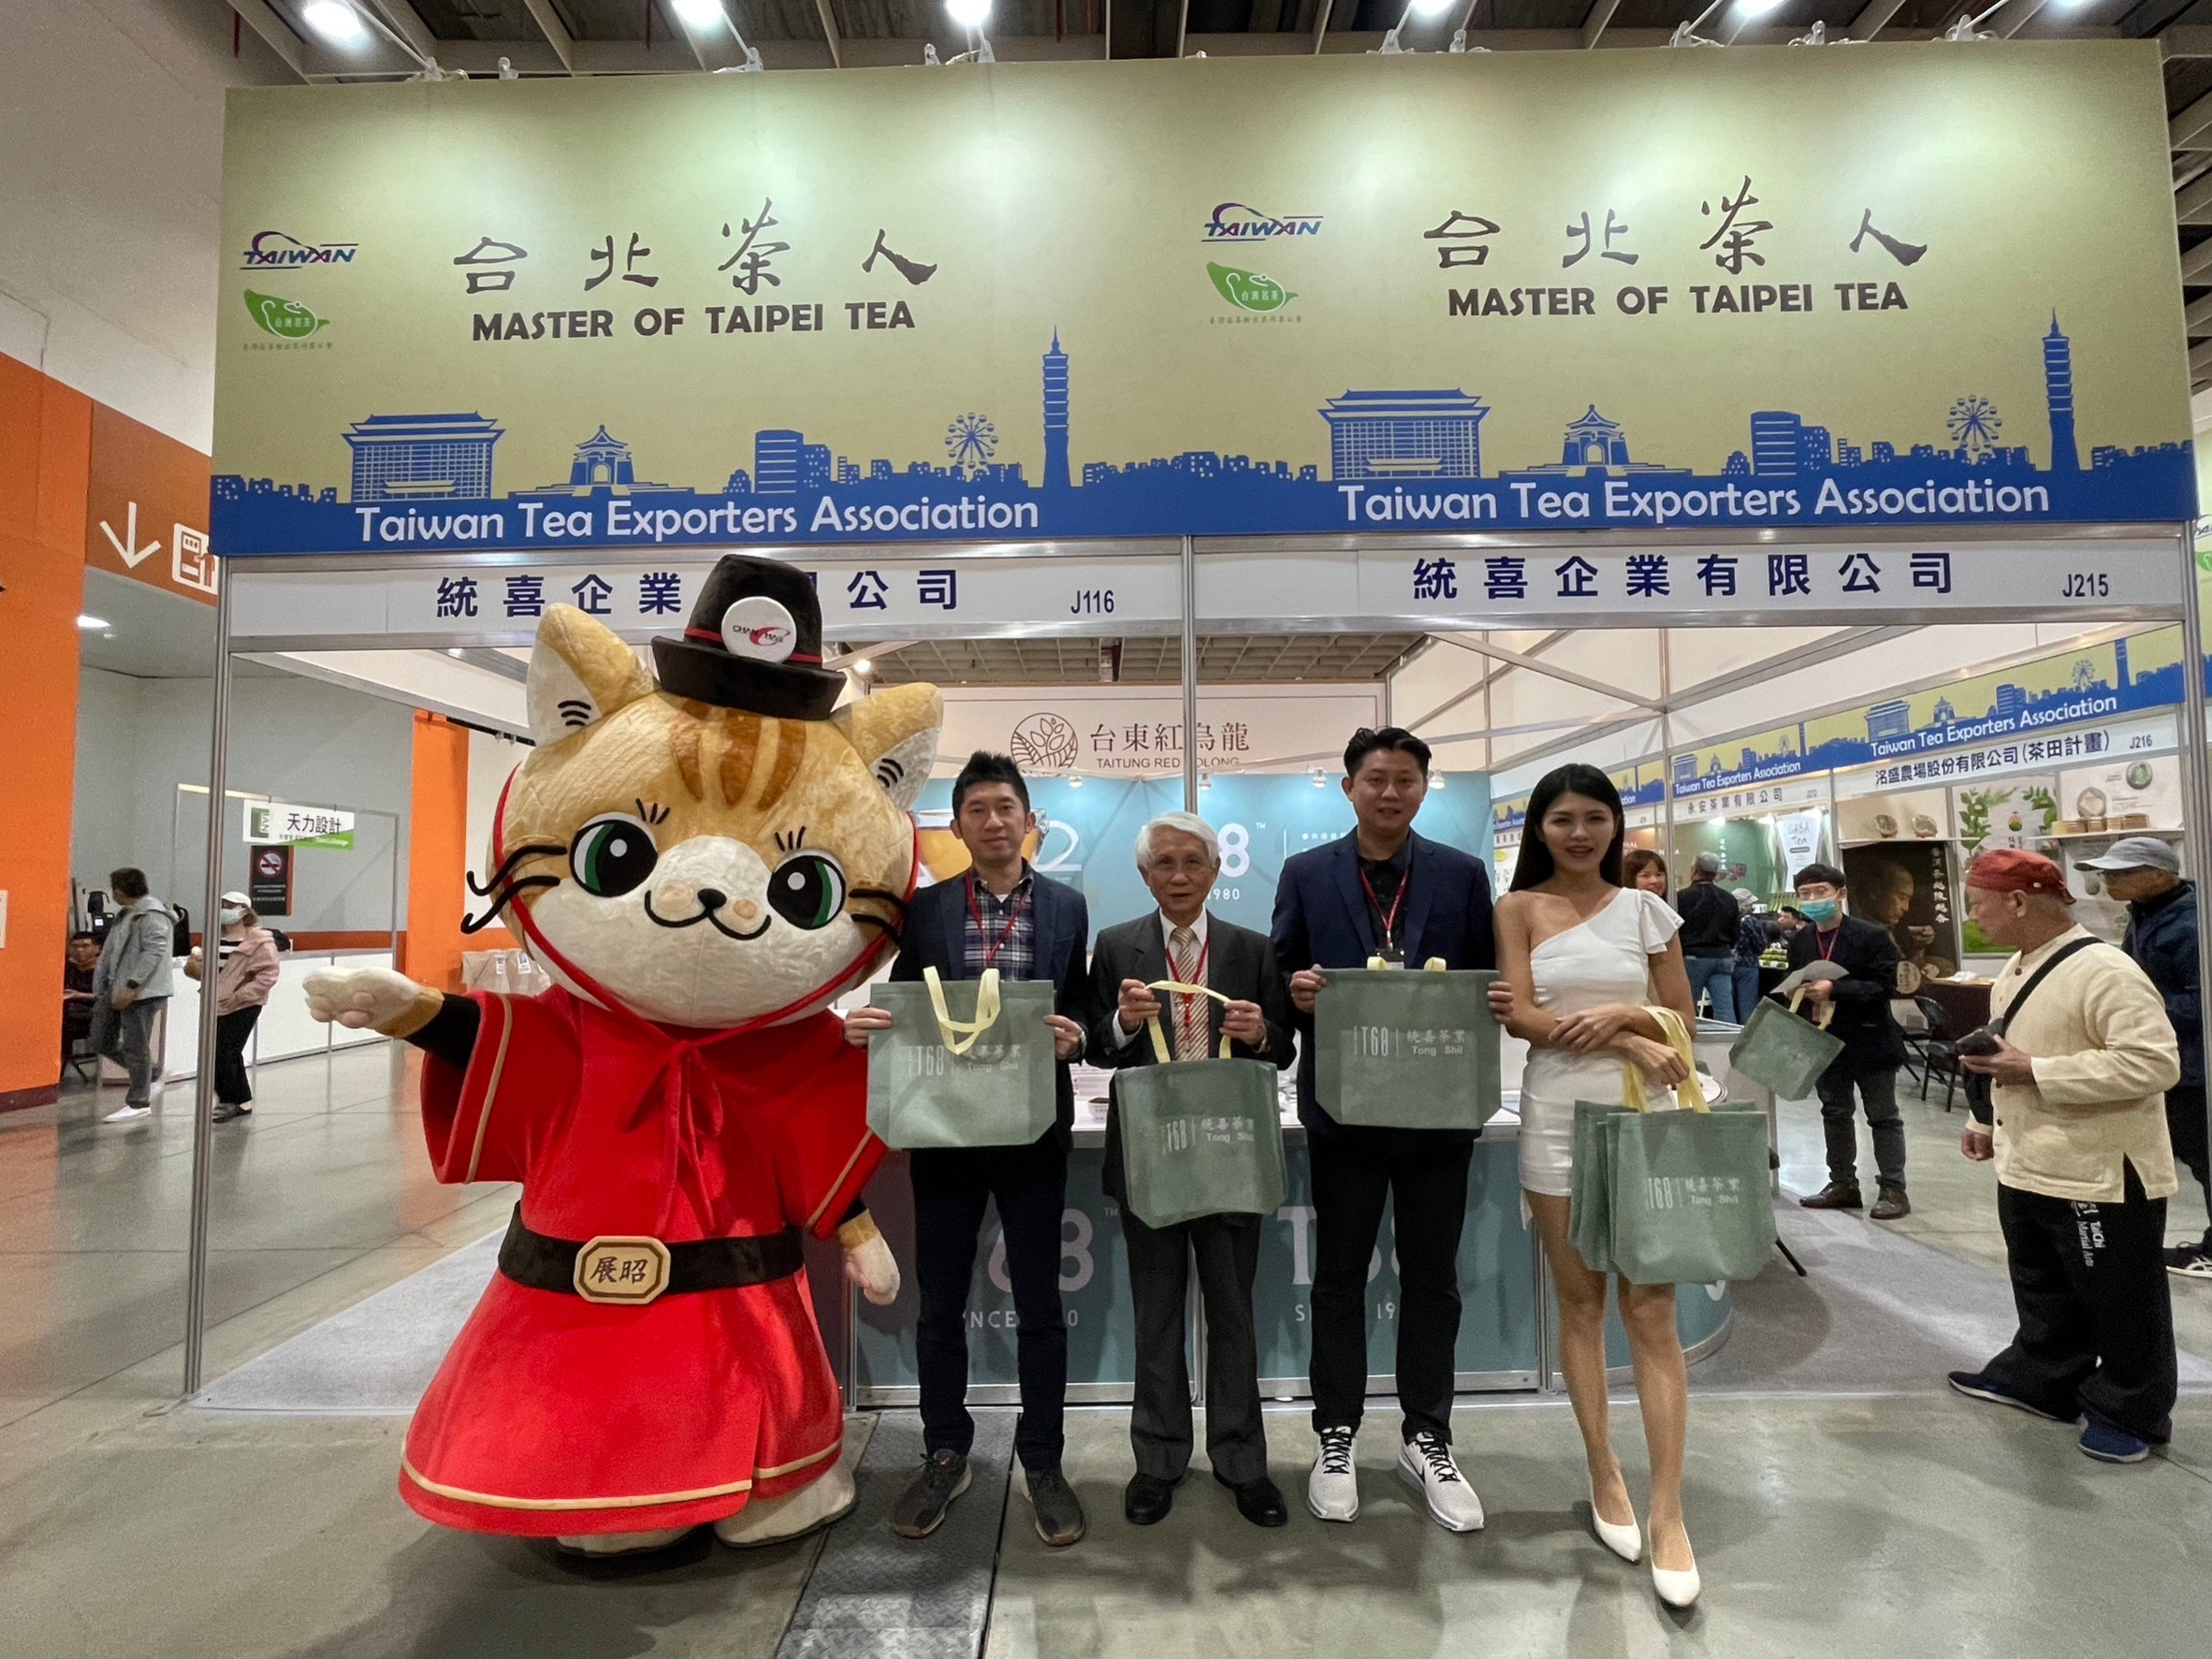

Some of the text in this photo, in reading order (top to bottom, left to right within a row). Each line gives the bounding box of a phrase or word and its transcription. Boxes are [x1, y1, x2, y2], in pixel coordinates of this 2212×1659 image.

[1204, 213, 1321, 237] TAIWAN
[1424, 175, 1928, 274] 台北茶人
[242, 240, 357, 265] TAIWAN
[454, 197, 938, 295] 台北茶人
[1448, 282, 1909, 316] MASTER OF TAIPEI TEA
[473, 300, 916, 342] MASTER OF TAIPEI TEA
[1338, 477, 2050, 524] Taiwan Tea Exporters Association
[356, 495, 1040, 543] Taiwan Tea Exporters Association
[1413, 552, 1952, 599] 統喜企業有限公司
[2062, 574, 2109, 599] J215
[437, 570, 956, 618] 統喜企業公司
[1070, 589, 1114, 614] J116
[1090, 722, 1250, 751] 台東紅烏龍
[1870, 694, 2117, 757] Taiwan Tea Exporters Association
[2129, 735, 2152, 749] J216
[1096, 756, 1240, 768] TAITUNG RED OLONG
[1675, 761, 1801, 794] Taiwan Tea Exporters Association
[1688, 788, 1783, 814] 永安茶業有限公司
[287, 812, 342, 836] 天力設計
[1360, 1026, 1389, 1056] T68
[1411, 1046, 1436, 1056] Tong
[589, 1256, 648, 1284] 展昭
